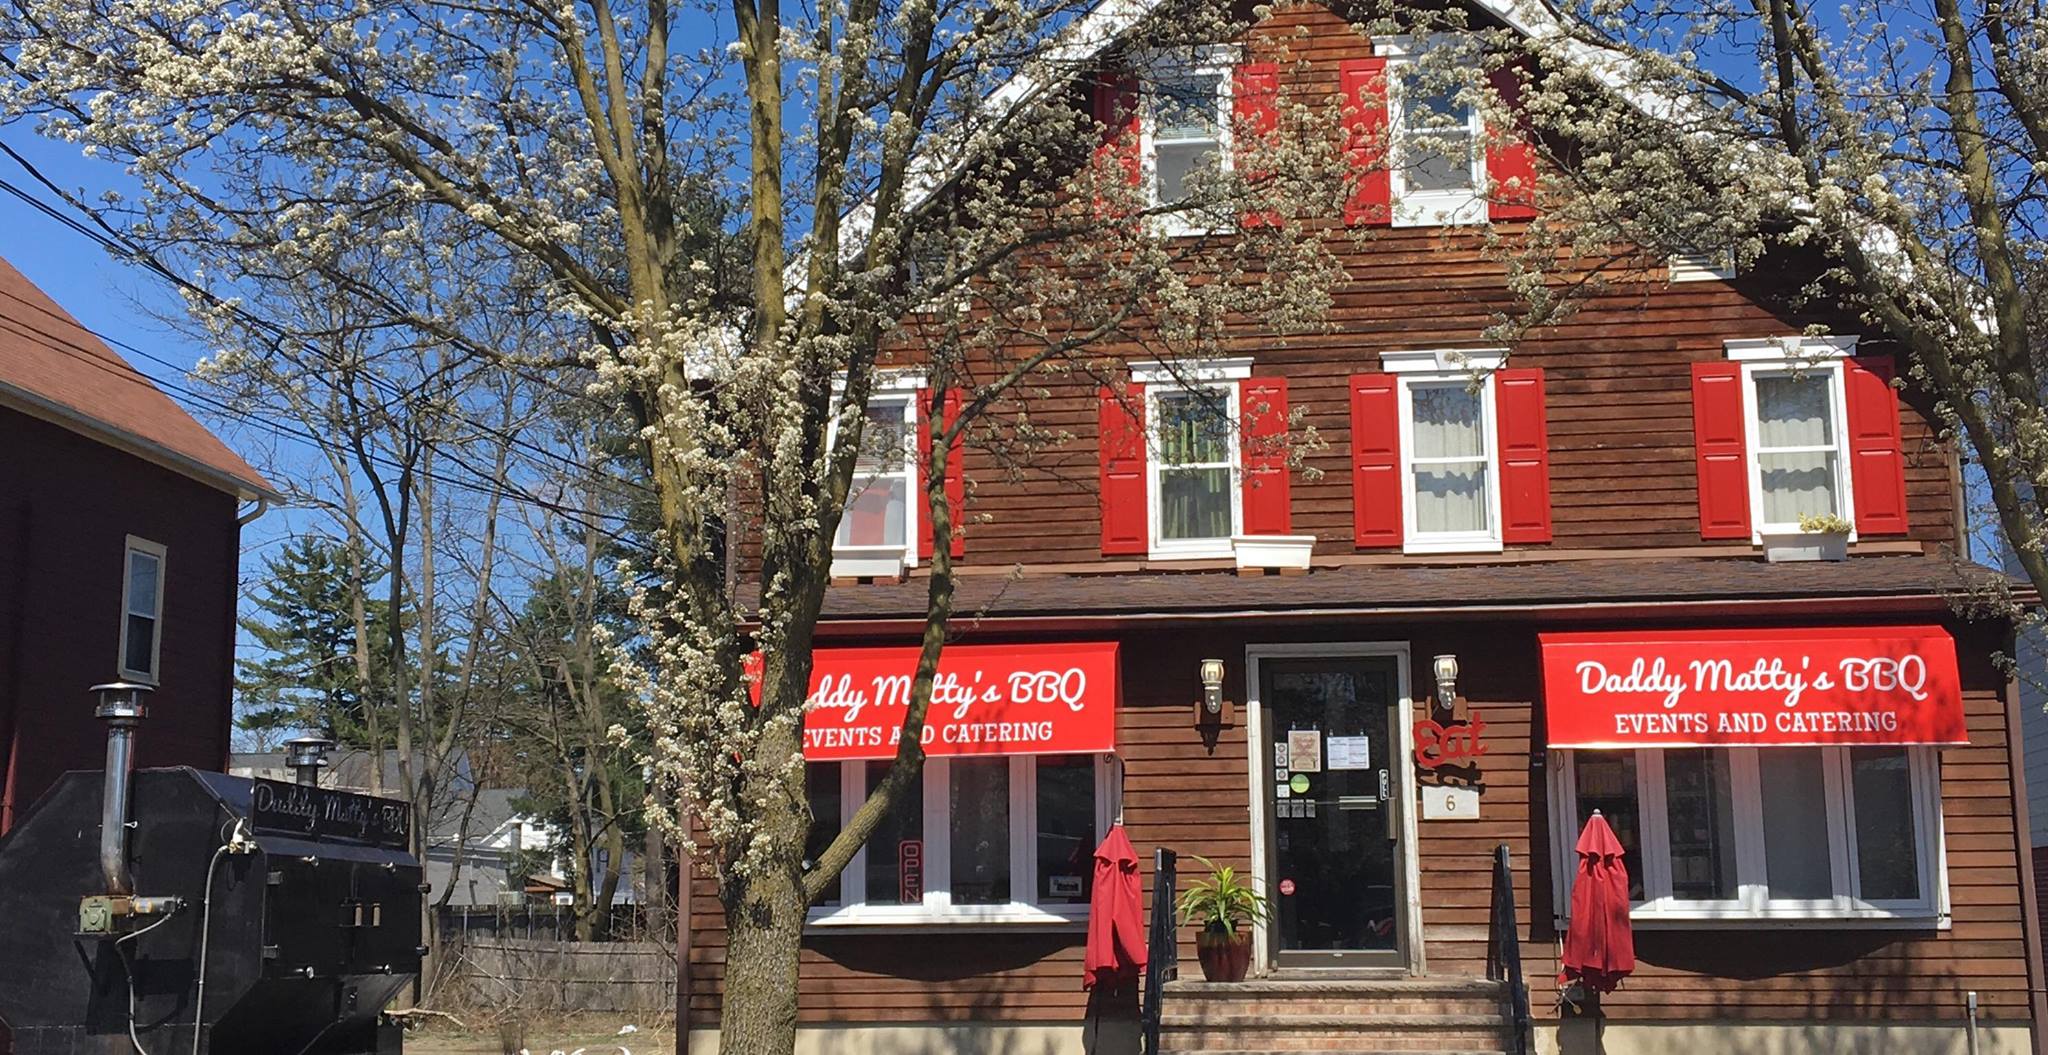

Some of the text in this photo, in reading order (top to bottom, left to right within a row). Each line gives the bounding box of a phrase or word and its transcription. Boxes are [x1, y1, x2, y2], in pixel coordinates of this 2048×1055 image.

[806, 667, 1087, 724] ddy Mtty's BBQ
[1576, 654, 1929, 709] Daddy Matty's BBQ
[888, 724, 935, 746] AD
[942, 721, 1053, 744] CATERING
[1412, 711, 1489, 768] Eat
[1615, 711, 1898, 735] EVENTS AND CATERING
[1446, 794, 1457, 812] 6
[904, 844, 920, 903] OPEN
